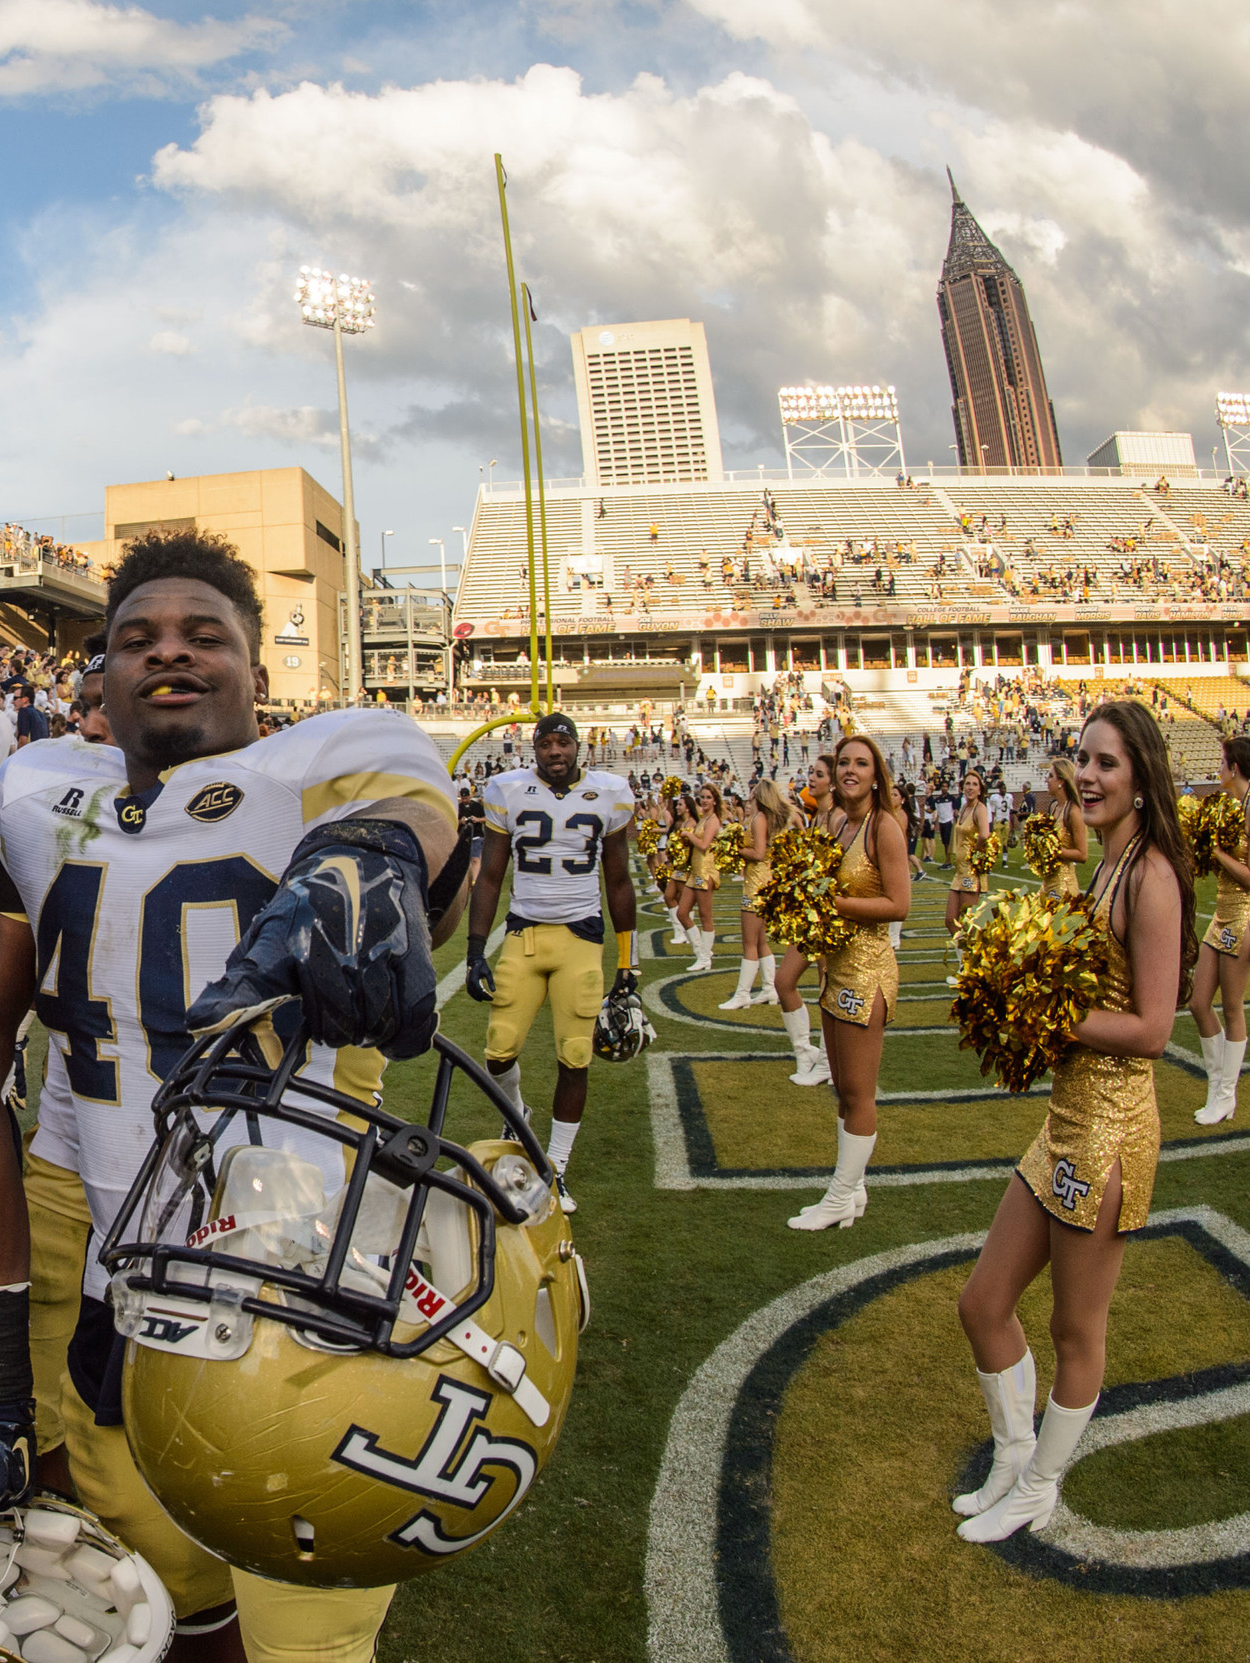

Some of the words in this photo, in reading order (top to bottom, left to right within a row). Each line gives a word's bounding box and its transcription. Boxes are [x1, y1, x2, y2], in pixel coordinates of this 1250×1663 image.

[760, 618, 796, 630] SHAW
[906, 613, 937, 625] HALL
[939, 613, 955, 624] OF
[957, 613, 992, 624] FAME
[1009, 612, 1057, 622] BAUGHAN
[1075, 611, 1111, 621] MORRIS
[556, 624, 576, 635] OF
[577, 623, 617, 634] FAME
[638, 622, 679, 632] GUYON
[194, 787, 235, 811] ACC
[1001, 800, 1008, 812] 3
[52, 804, 82, 817] RUSSELL
[121, 805, 143, 824] GT
[513, 809, 604, 875] 23
[35, 852, 312, 1112] 40
[837, 987, 865, 1016] GT
[1052, 1157, 1091, 1212] GT
[139, 1316, 200, 1344] ACC
[329, 1372, 539, 1557] GT
